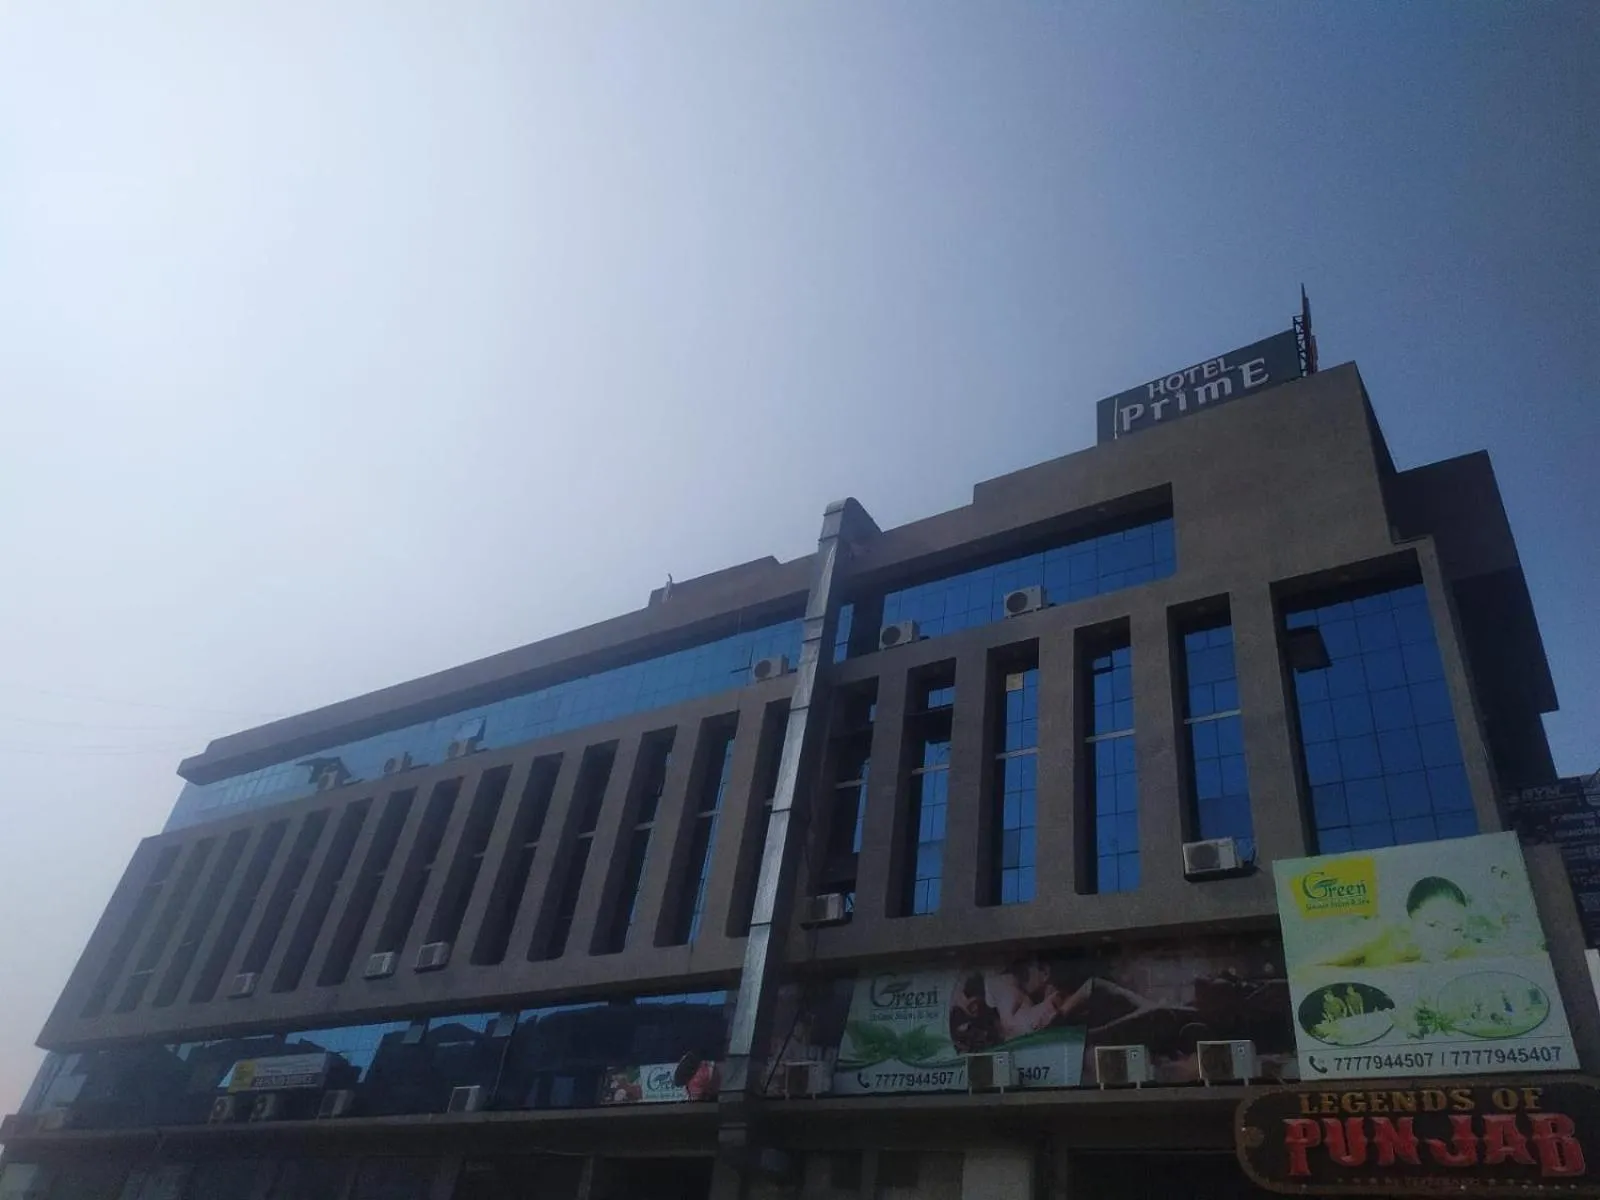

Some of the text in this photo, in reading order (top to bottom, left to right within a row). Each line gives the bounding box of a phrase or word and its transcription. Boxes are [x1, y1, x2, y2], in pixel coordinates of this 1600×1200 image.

[1149, 357, 1235, 398] HOTEL
[1302, 872, 1367, 899] Green
[870, 972, 939, 1008] Green
[1334, 1053, 1433, 1070] 7777944507
[1453, 1046, 1562, 1067] 7777945407
[875, 1072, 954, 1087] 7777944507
[1300, 1087, 1544, 1115] LEGENDS OF
[1283, 1114, 1586, 1177] PUNJAB
